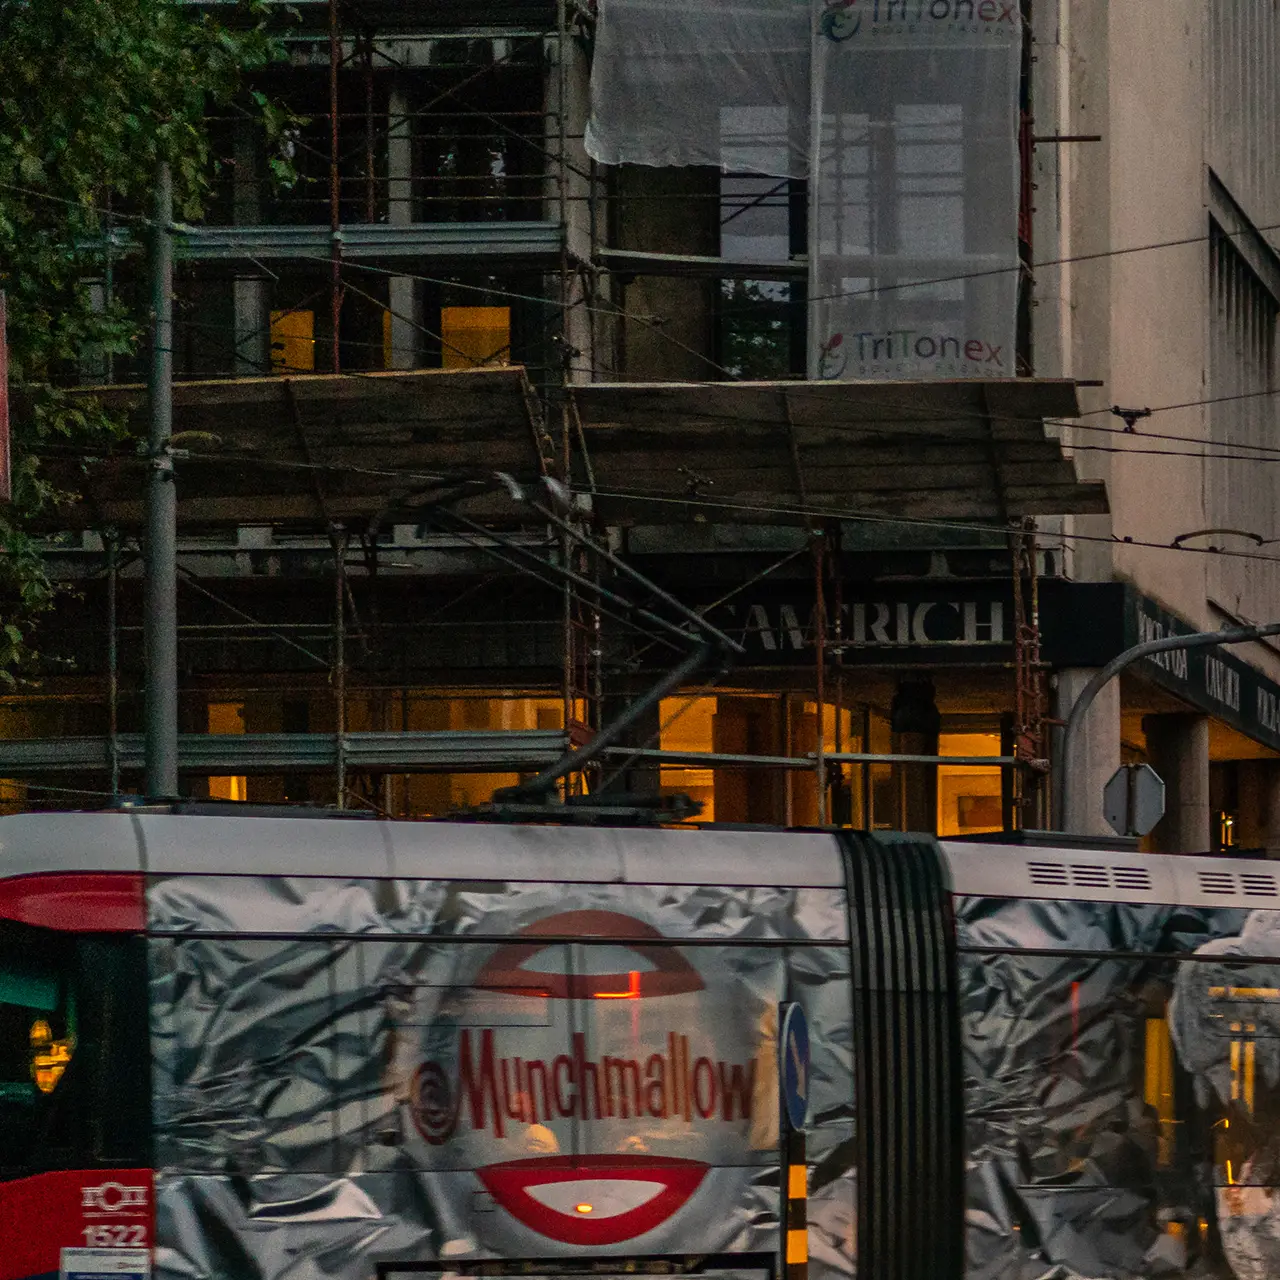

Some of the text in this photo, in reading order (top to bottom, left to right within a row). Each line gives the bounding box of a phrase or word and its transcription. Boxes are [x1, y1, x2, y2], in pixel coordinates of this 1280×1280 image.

[853, 330, 1004, 367] TriTonex
[459, 1028, 759, 1139] Munchmallow
[80, 1224, 148, 1249] 1522
